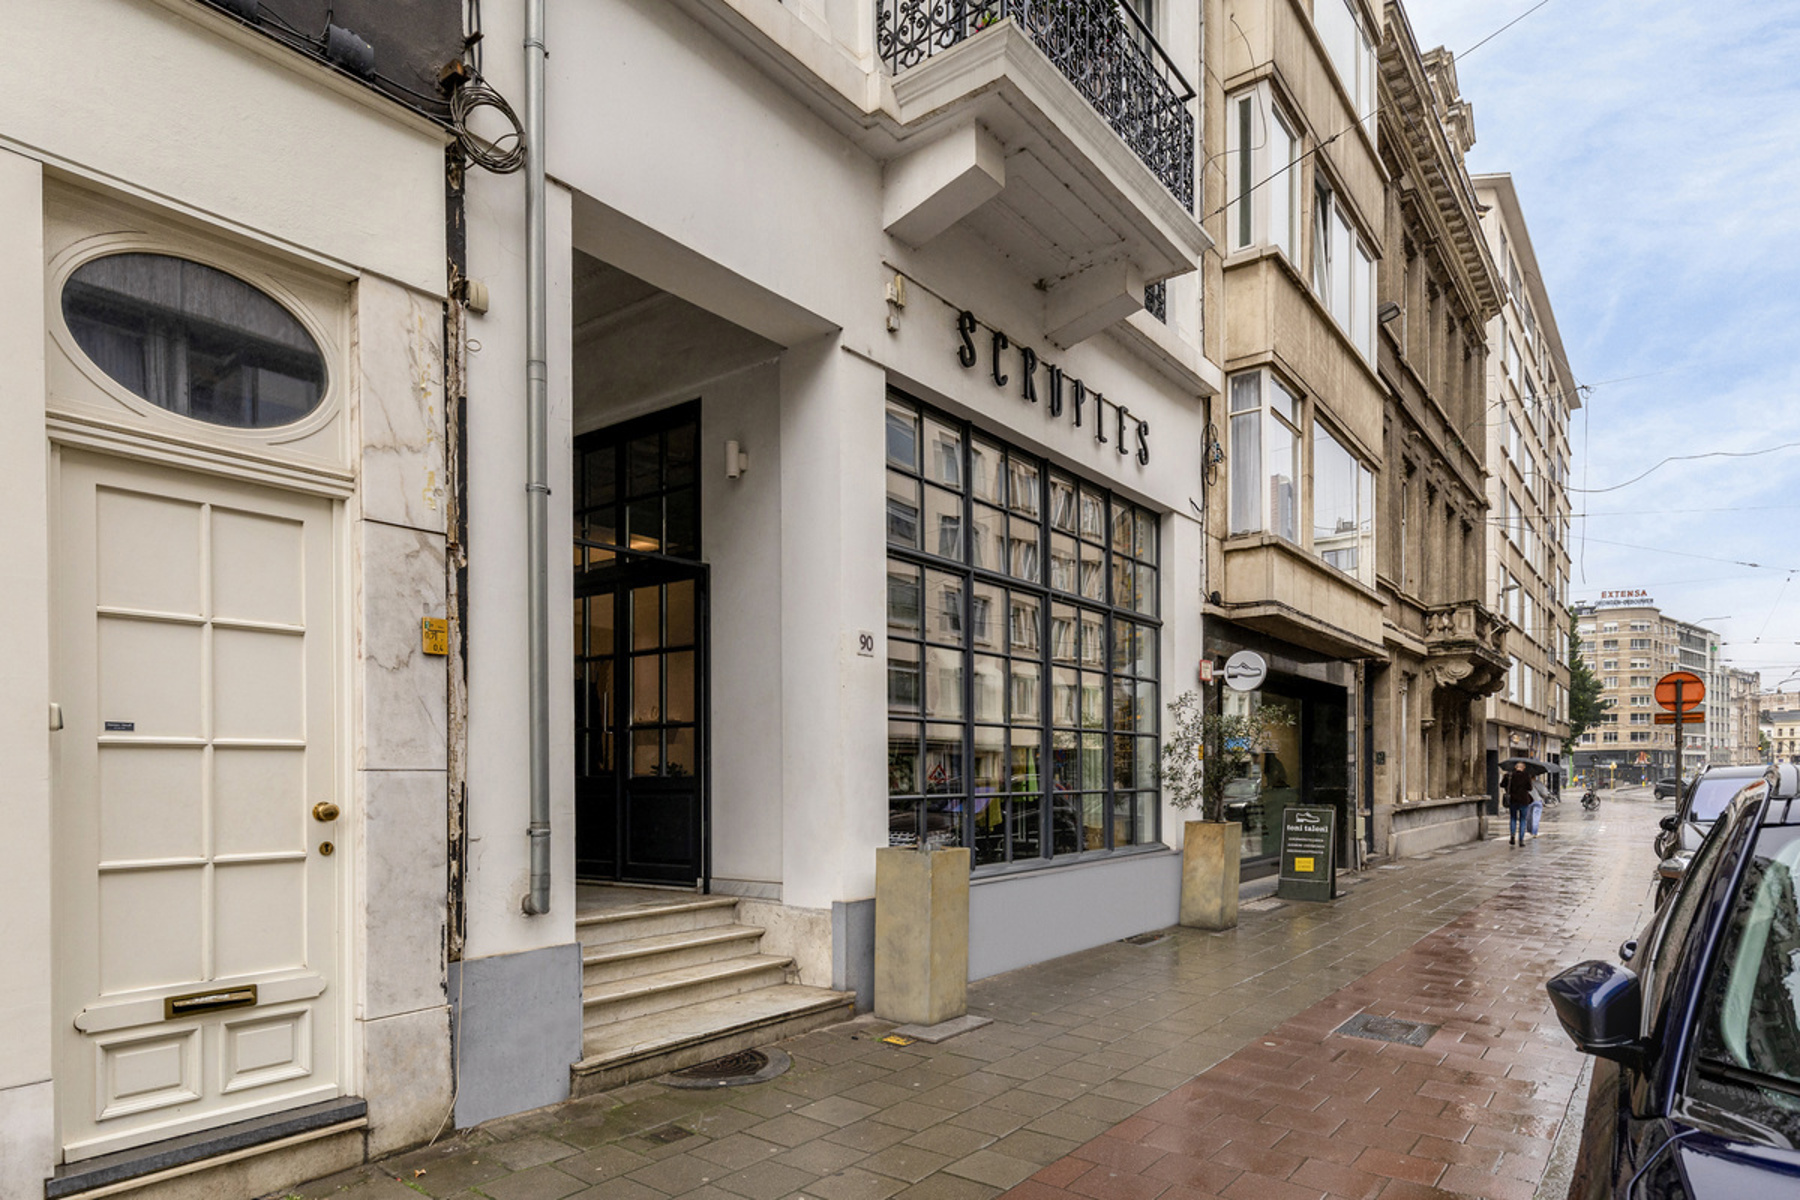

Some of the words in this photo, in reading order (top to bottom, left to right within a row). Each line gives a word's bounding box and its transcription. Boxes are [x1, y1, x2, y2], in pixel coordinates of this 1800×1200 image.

[956, 310, 1150, 466] SCRUPLES
[1601, 589, 1648, 599] EXTENSA
[859, 633, 874, 652] 90
